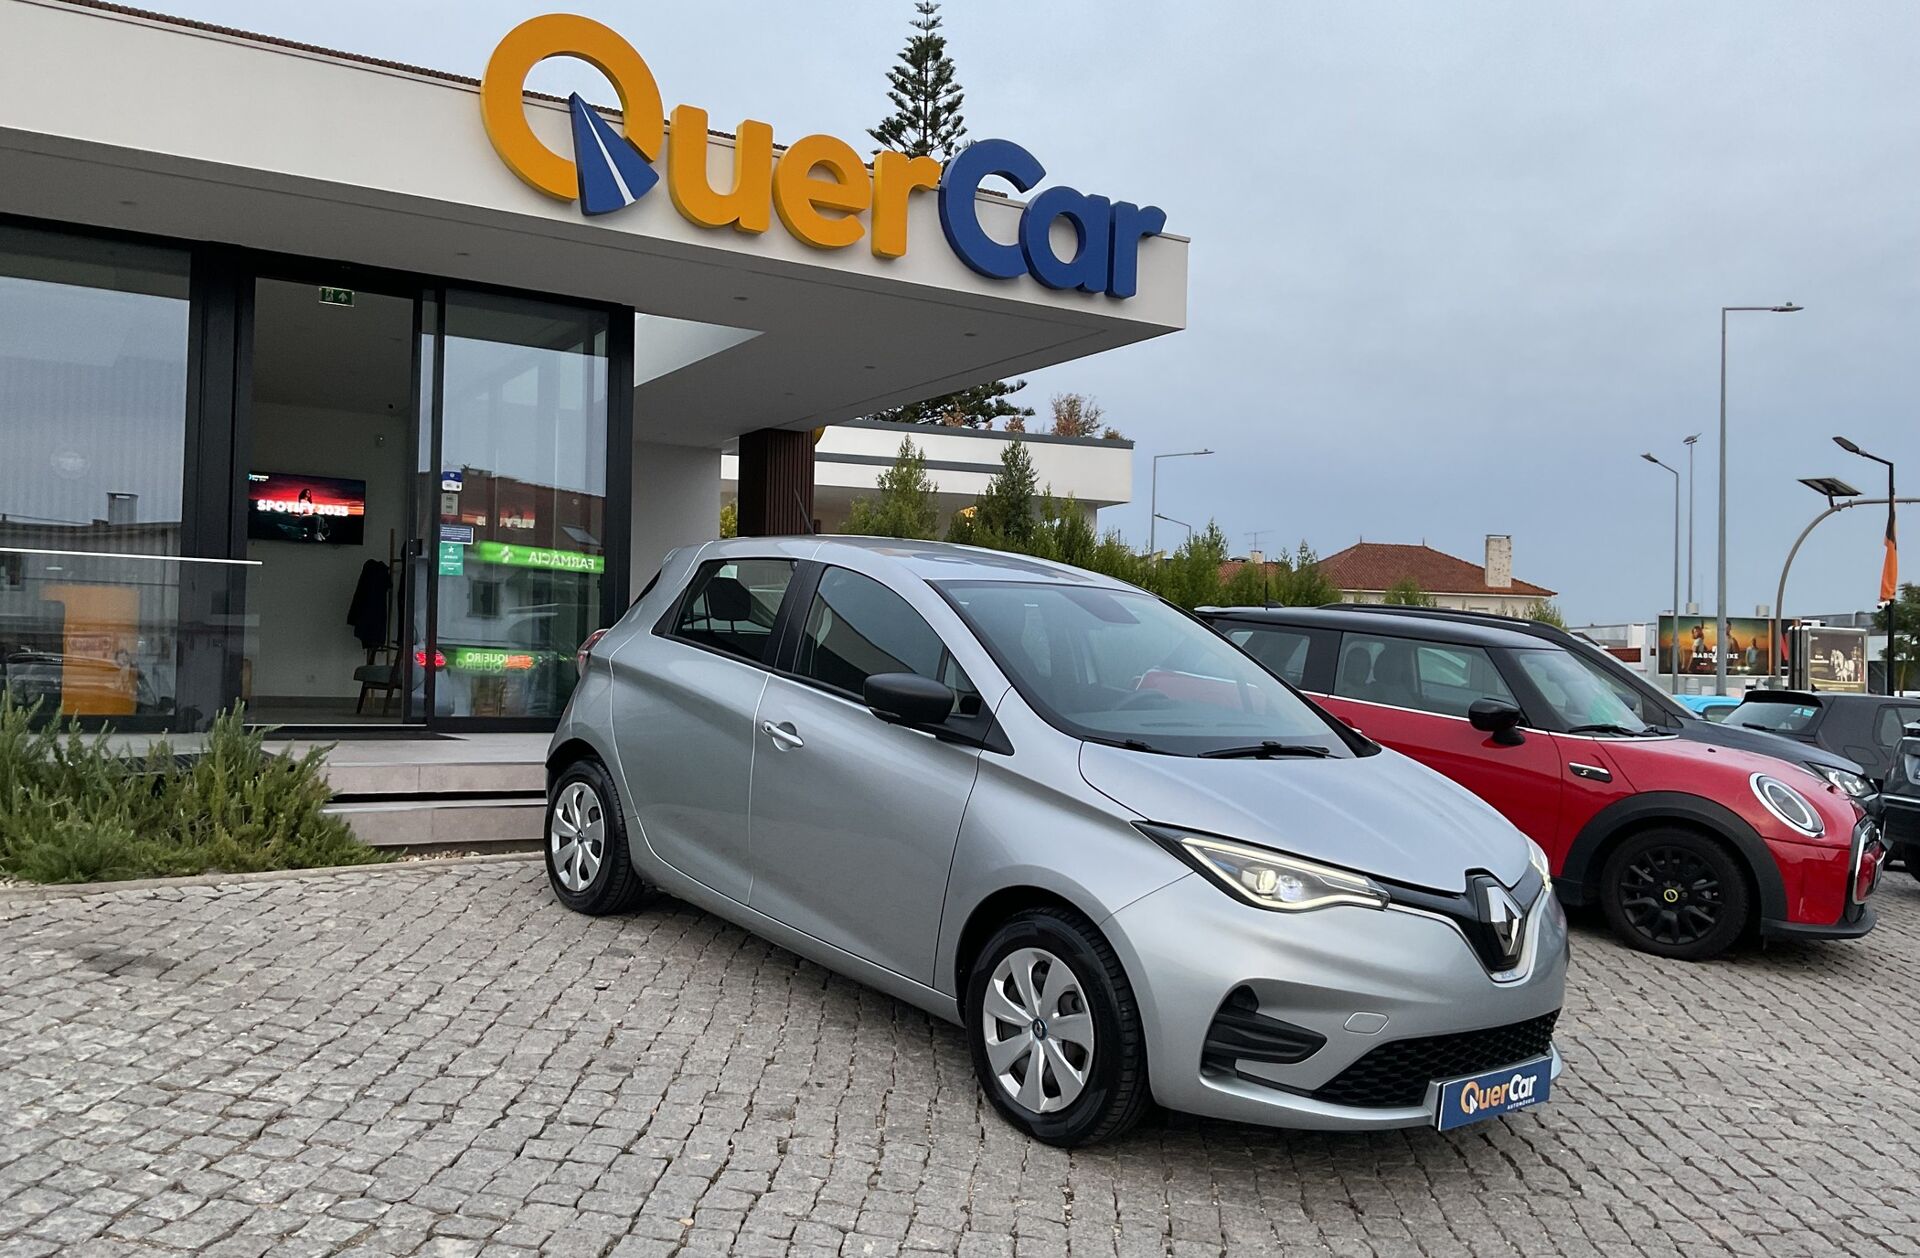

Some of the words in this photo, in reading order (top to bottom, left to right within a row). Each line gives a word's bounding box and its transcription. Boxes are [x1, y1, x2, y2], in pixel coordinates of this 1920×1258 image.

[481, 13, 1167, 300] QuerCar
[257, 499, 316, 515] SPOTIFY
[1460, 1073, 1538, 1115] QuerCar
